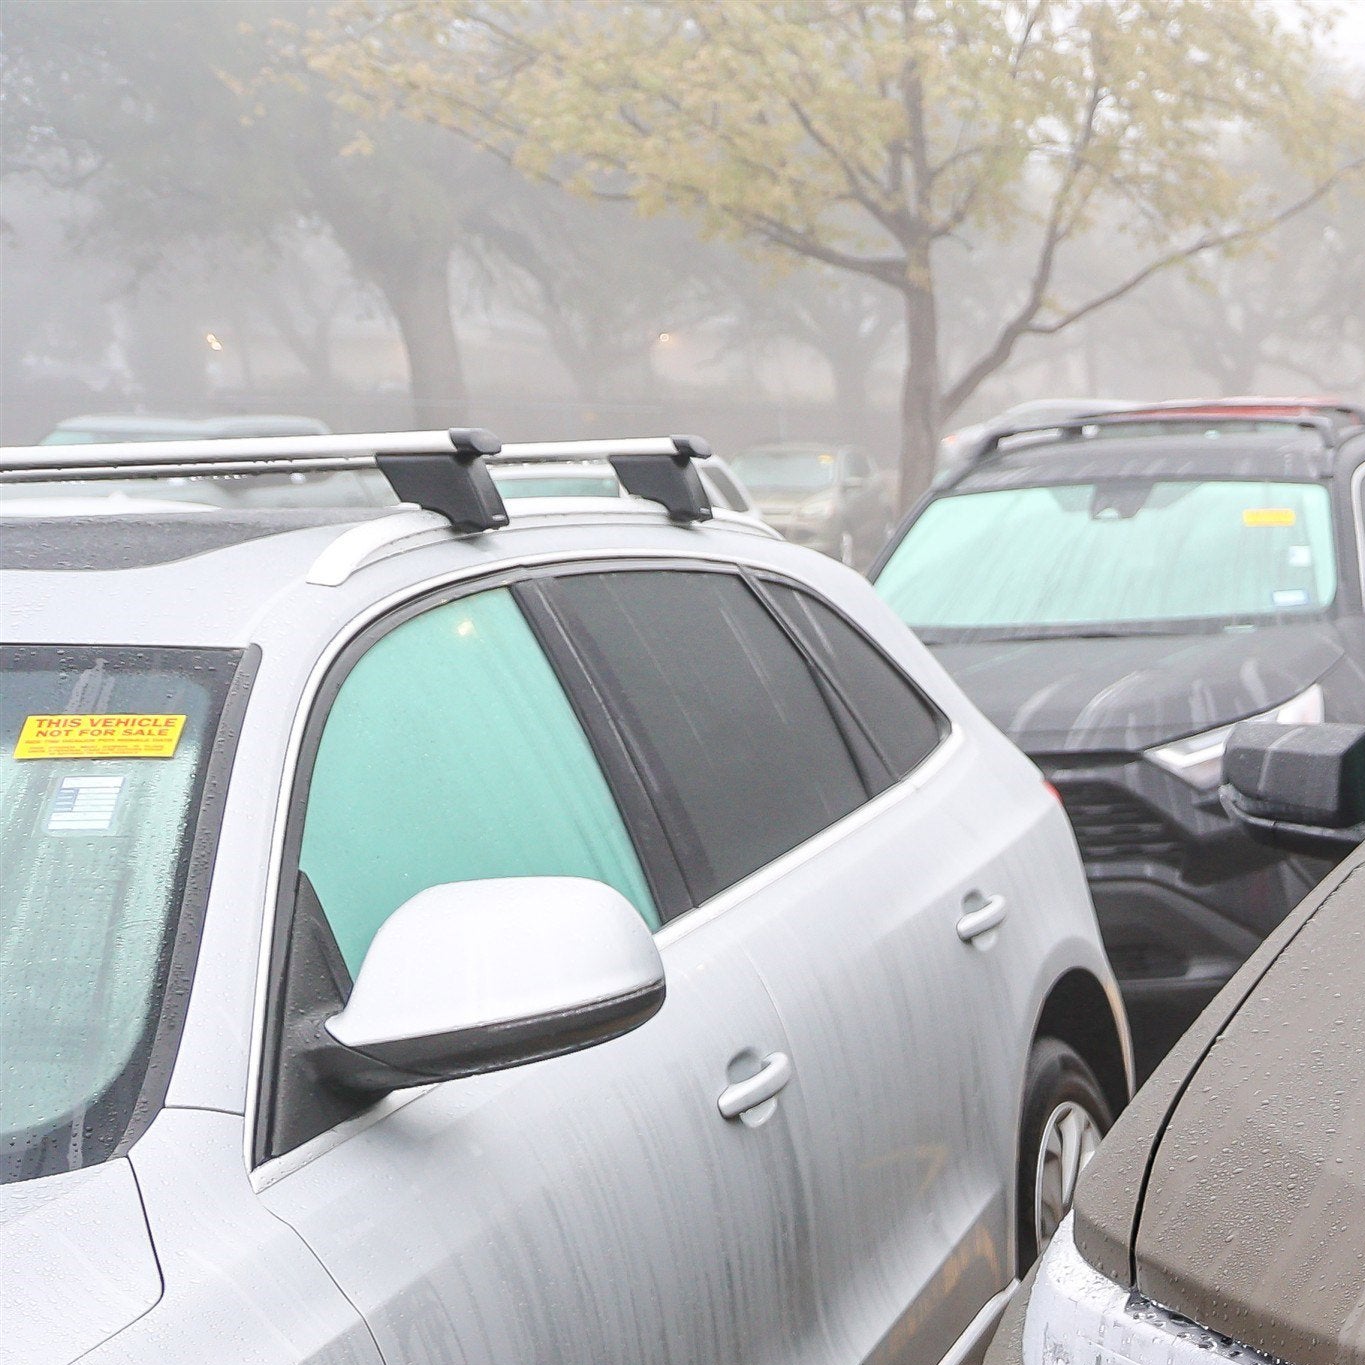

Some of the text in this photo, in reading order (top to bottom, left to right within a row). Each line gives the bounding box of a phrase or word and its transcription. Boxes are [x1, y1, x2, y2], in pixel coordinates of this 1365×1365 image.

[36, 717, 178, 728] THIS VEHICLE
[35, 728, 169, 738] NOT FOR SALE
